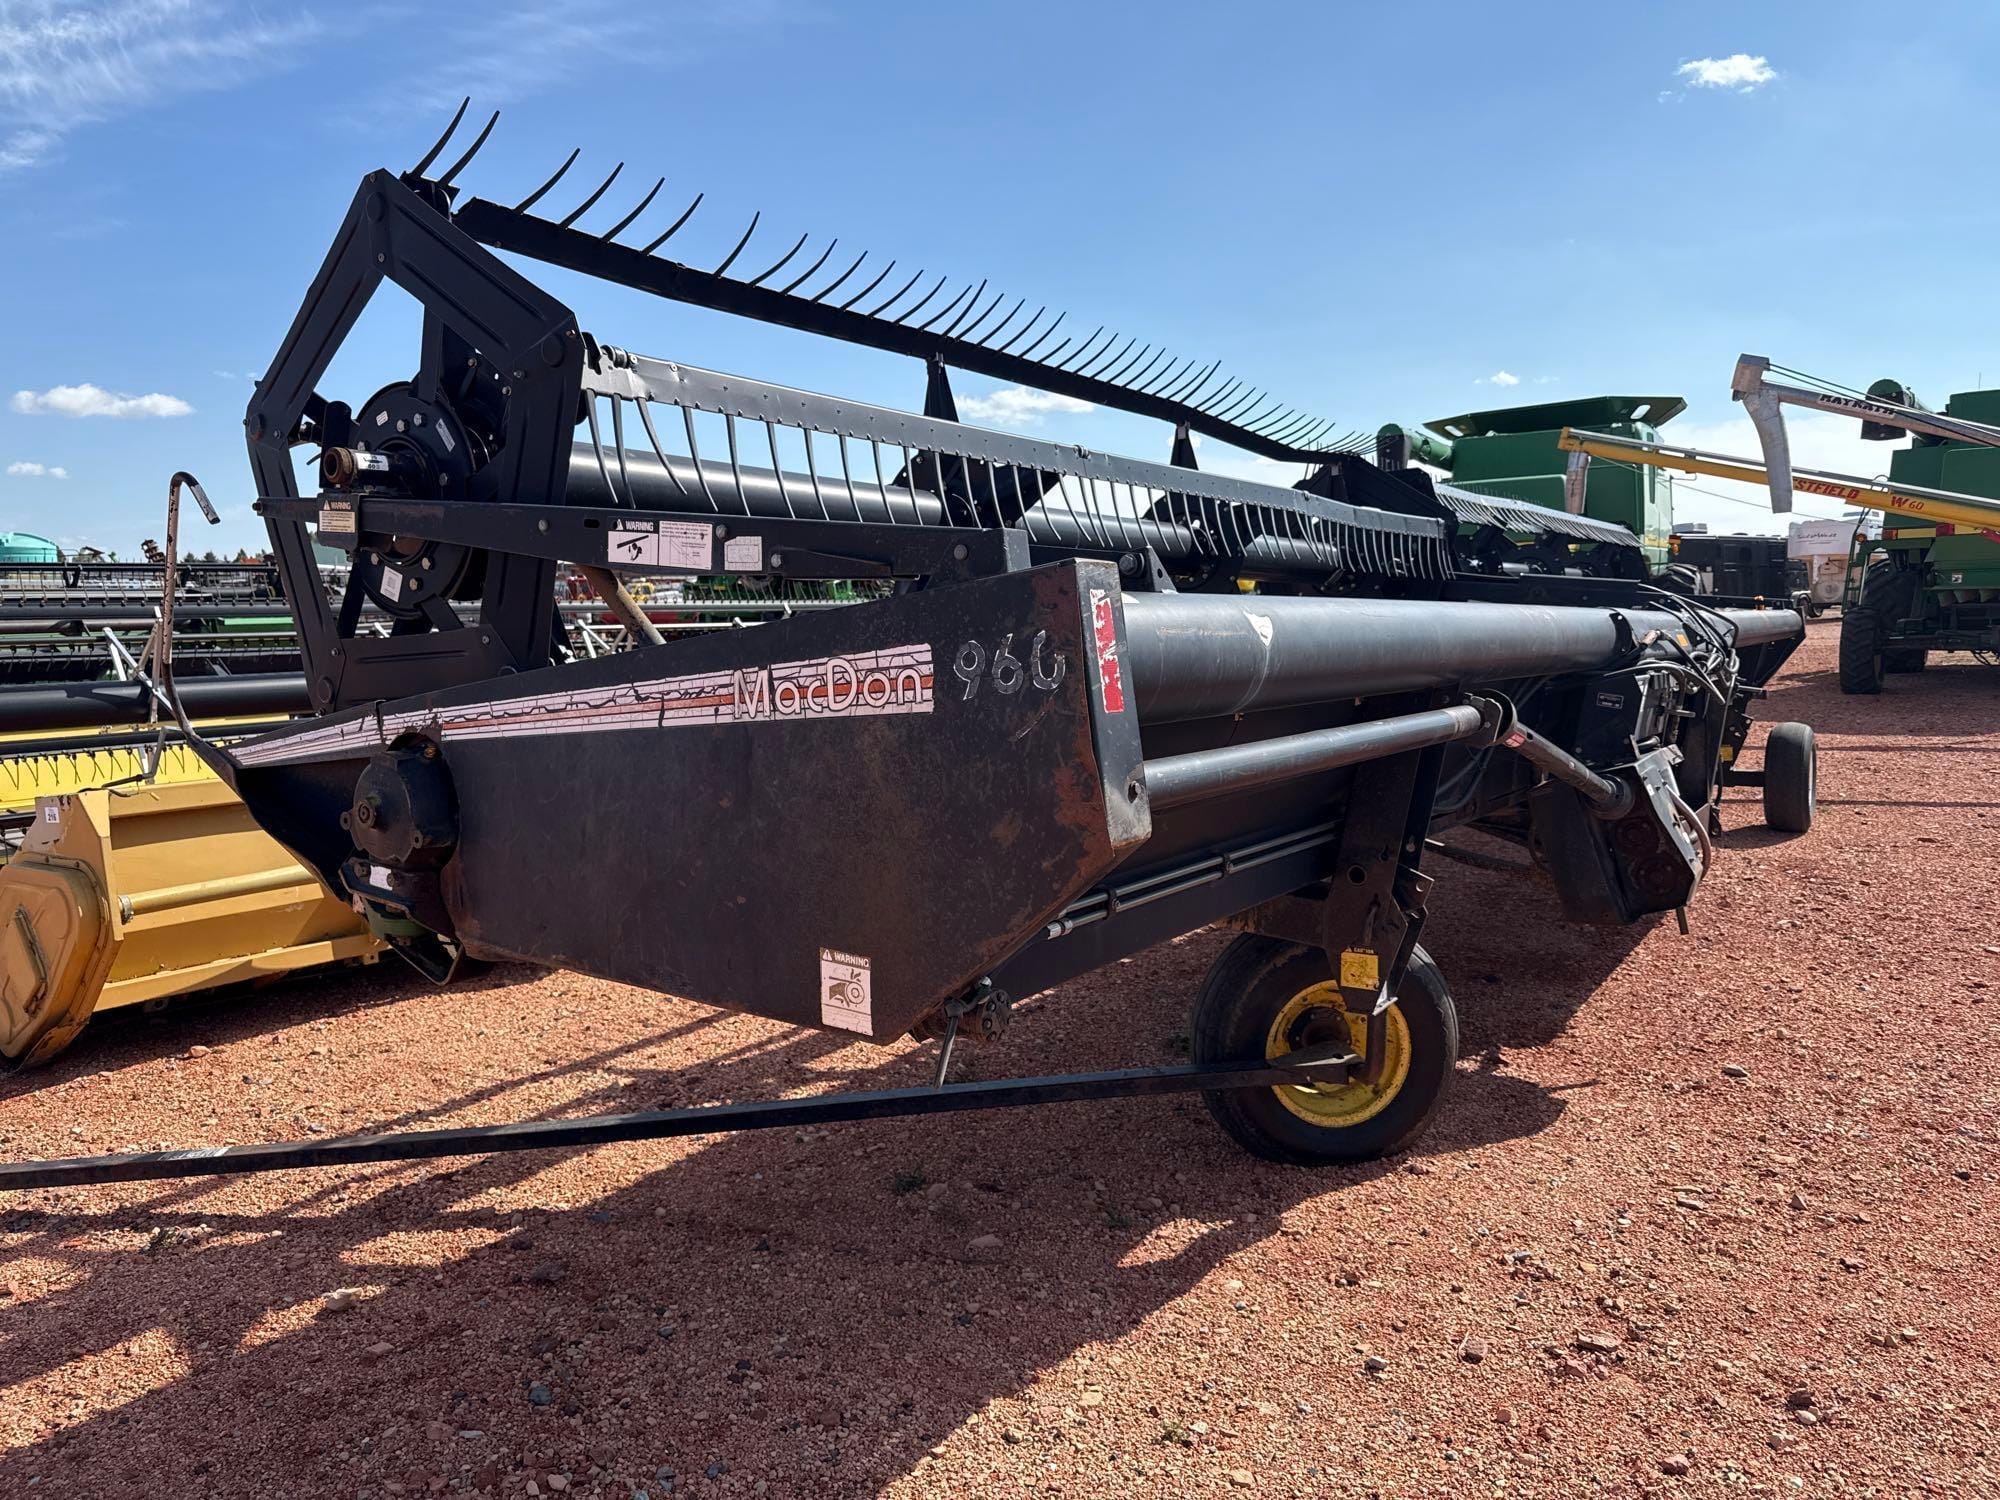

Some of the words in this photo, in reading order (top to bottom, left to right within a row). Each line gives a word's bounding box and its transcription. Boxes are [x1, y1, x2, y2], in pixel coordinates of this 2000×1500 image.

[625, 520, 654, 532] WARNING
[732, 656, 924, 719] MacDon
[834, 951, 869, 968] WARNING
